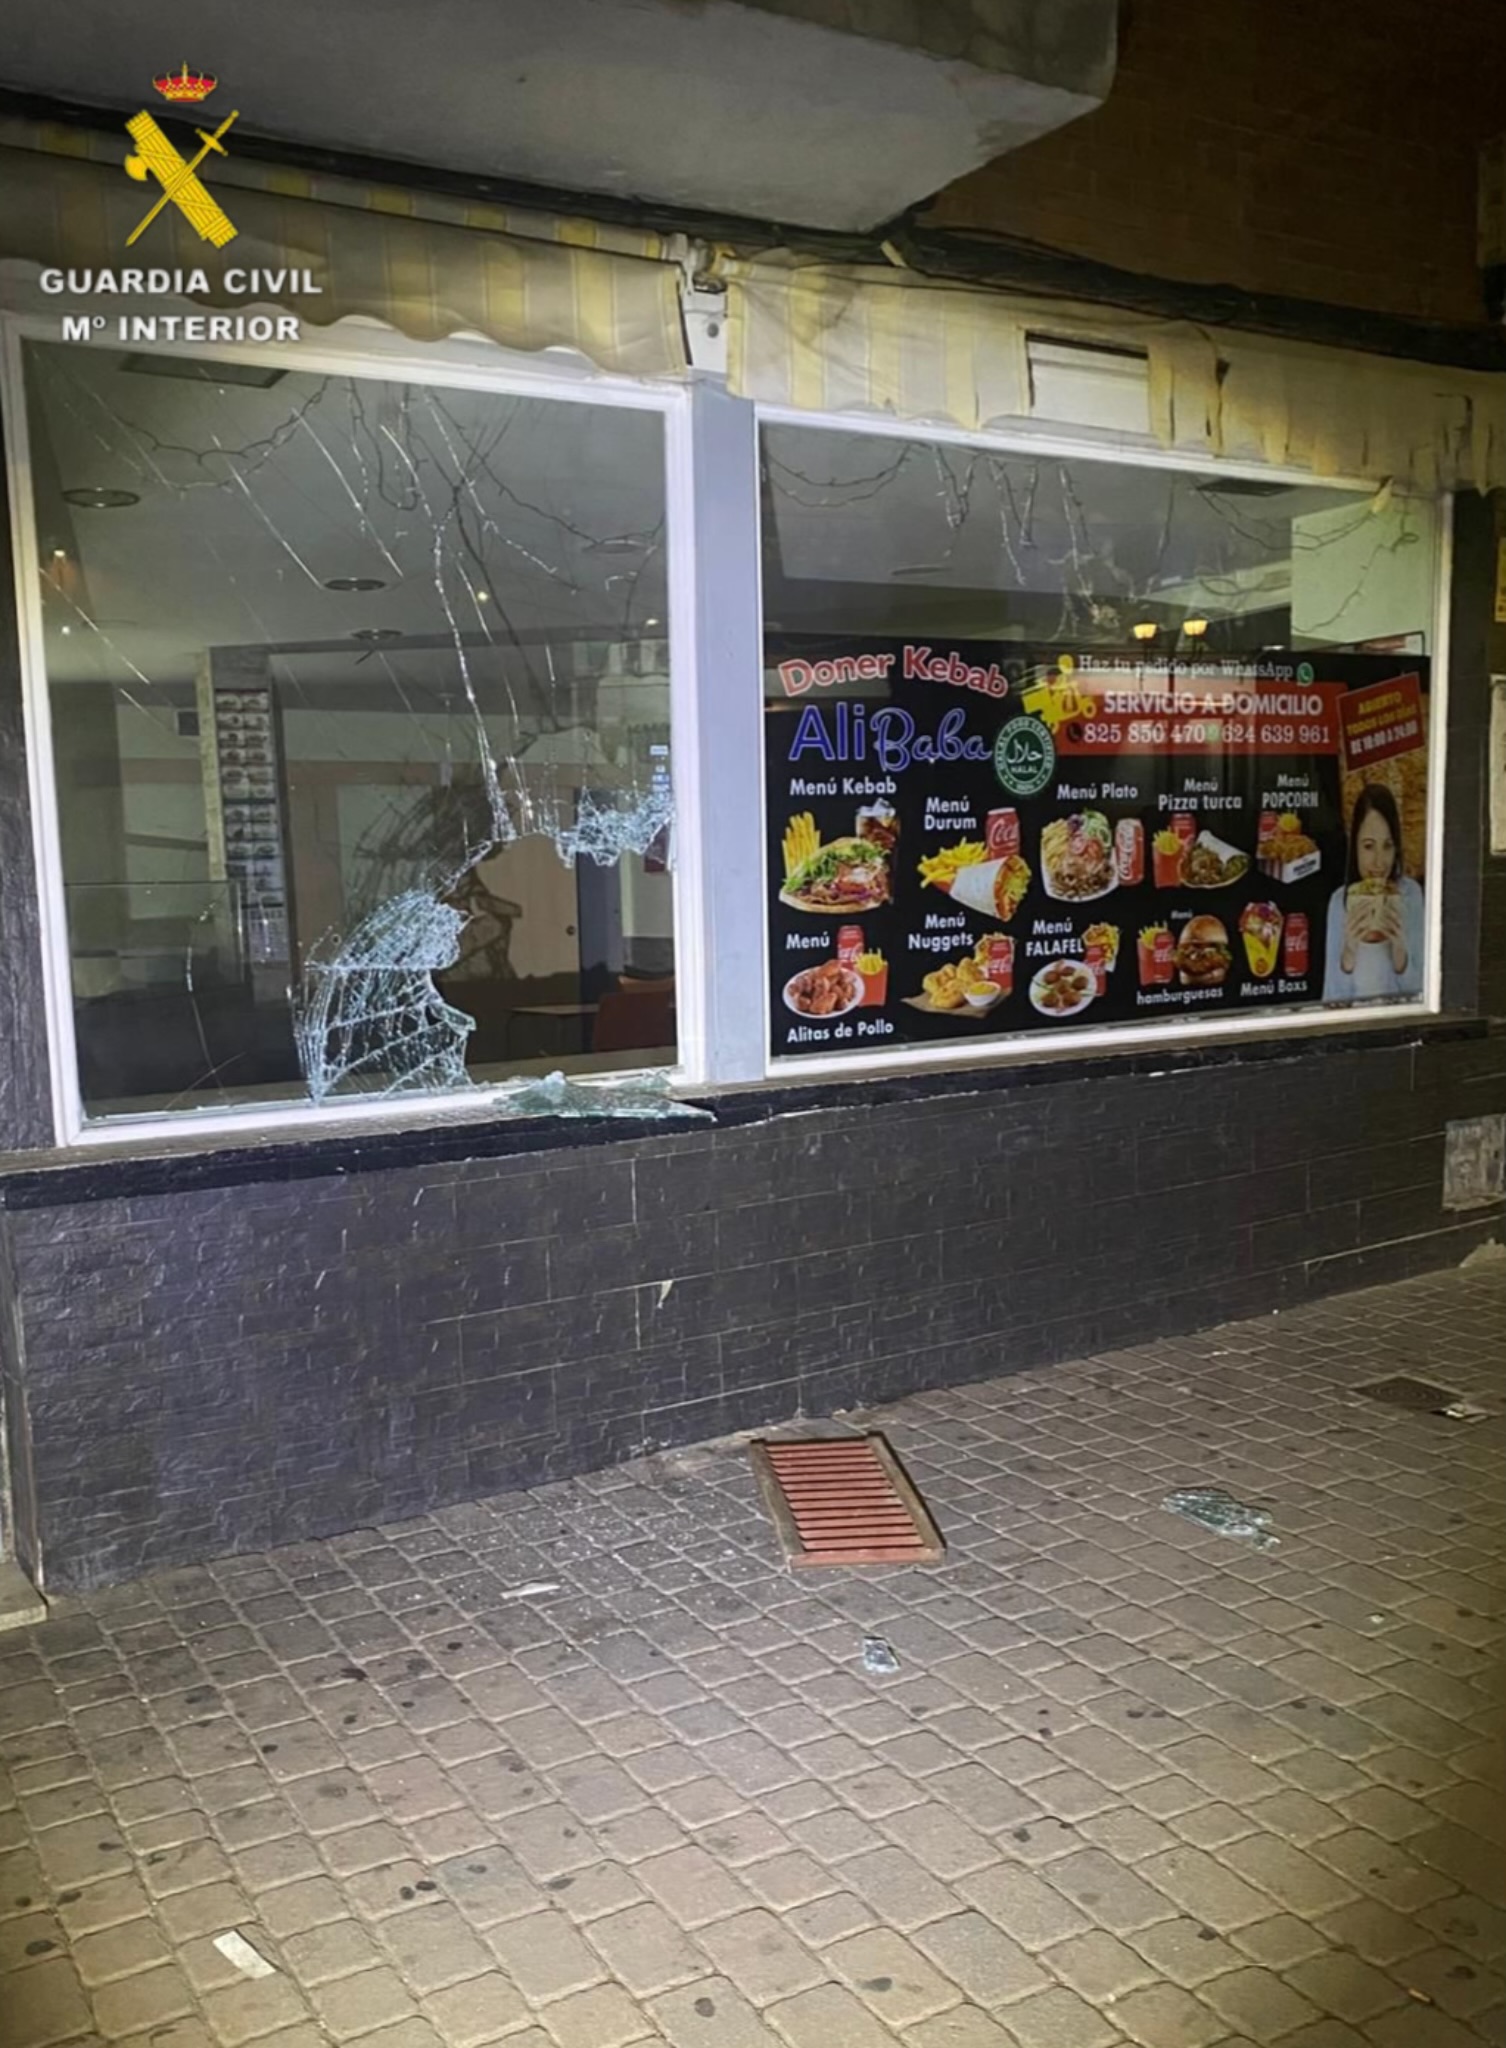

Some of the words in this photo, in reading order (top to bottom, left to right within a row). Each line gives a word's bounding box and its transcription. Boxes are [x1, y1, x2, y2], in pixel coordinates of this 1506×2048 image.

[778, 654, 895, 697] Doner
[903, 645, 1008, 698] Kebab
[1078, 655, 1109, 673] Haz
[1114, 658, 1131, 673] tu
[1190, 661, 1217, 680] por
[1220, 659, 1294, 682] WhatsApp
[1103, 690, 1196, 715] SERVICIO
[1201, 692, 1218, 714] A
[1221, 692, 1323, 716] DOMICILIO
[1084, 723, 1122, 743] 825
[1128, 723, 1165, 743] 850
[1170, 724, 1207, 743] 470
[1222, 723, 1256, 743] 624
[1261, 724, 1295, 744] 639
[1298, 725, 1330, 744] 961
[790, 777, 837, 796] Menú
[843, 776, 897, 794] Kebab
[1057, 782, 1098, 800] Menú
[1102, 783, 1138, 799] Plato
[1183, 777, 1219, 793] Menú
[926, 795, 970, 813] Menú
[1158, 794, 1198, 811] Pizza
[1203, 795, 1243, 809] turca
[1261, 791, 1319, 809] POPCORN
[924, 815, 977, 830] Durum
[924, 911, 966, 929] Menú
[1032, 917, 1073, 935] Menú
[786, 931, 830, 949] Menú
[907, 933, 974, 952] Nuggets
[1025, 937, 1084, 957] FALAFEL
[1136, 987, 1224, 1005] hamburguesas
[1240, 980, 1275, 997] Menú
[787, 1025, 831, 1044] Alitas
[834, 1022, 852, 1039] de
[857, 1019, 895, 1036] Pollo
